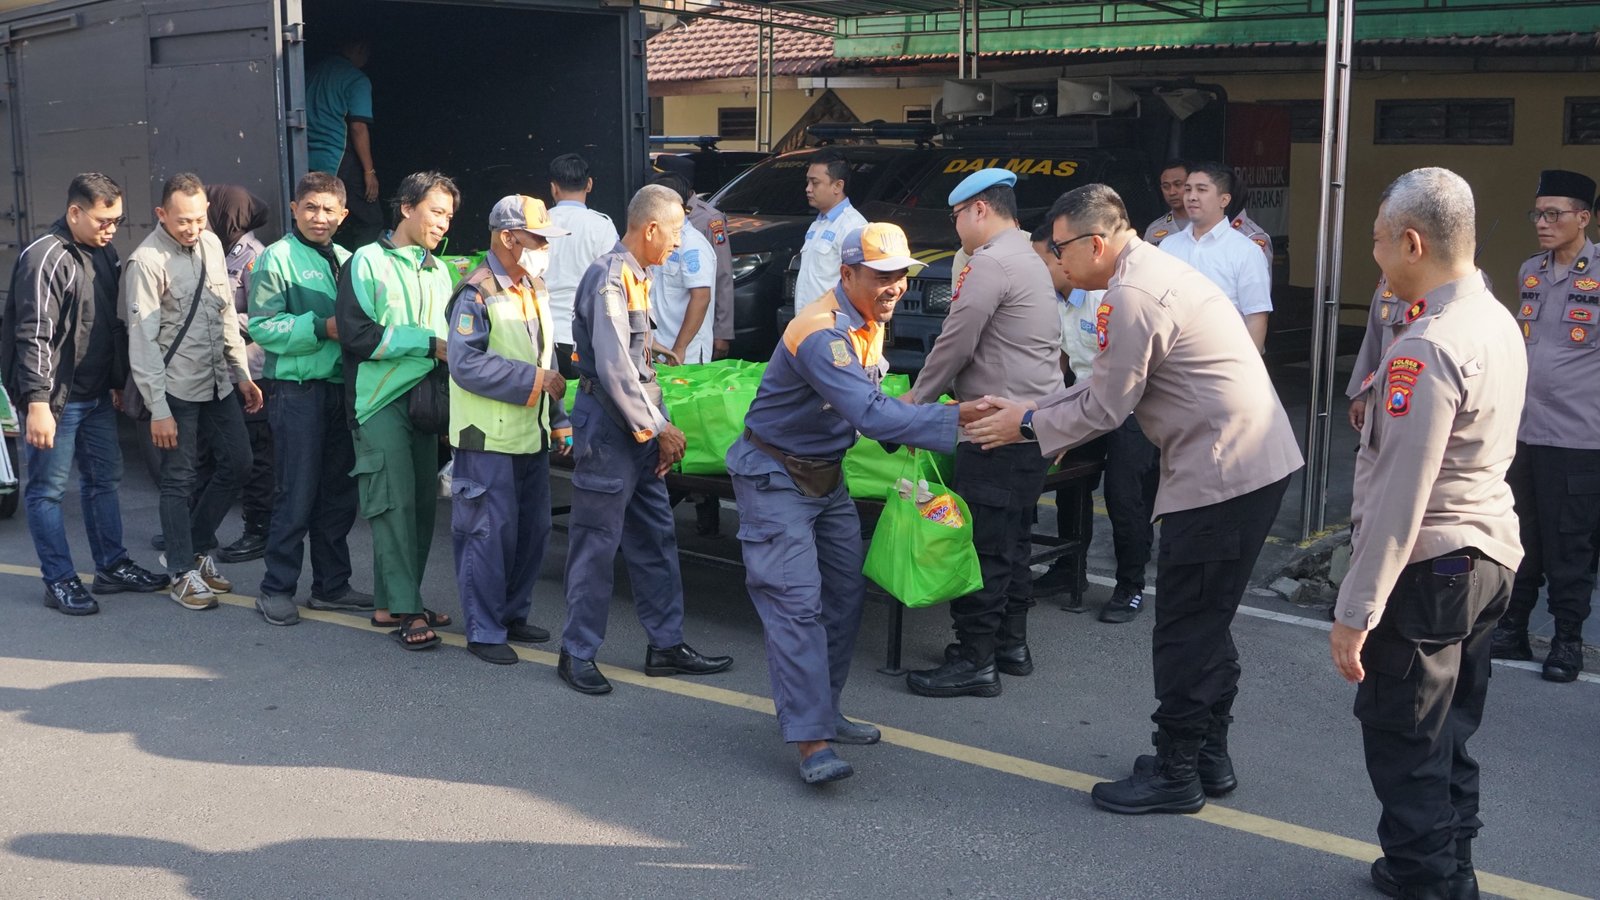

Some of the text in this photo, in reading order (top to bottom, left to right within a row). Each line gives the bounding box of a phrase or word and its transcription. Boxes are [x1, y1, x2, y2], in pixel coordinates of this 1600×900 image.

[943, 158, 1078, 177] DALMAS
[1256, 167, 1285, 185] UNTUK
[1246, 189, 1285, 209] YARAKAT
